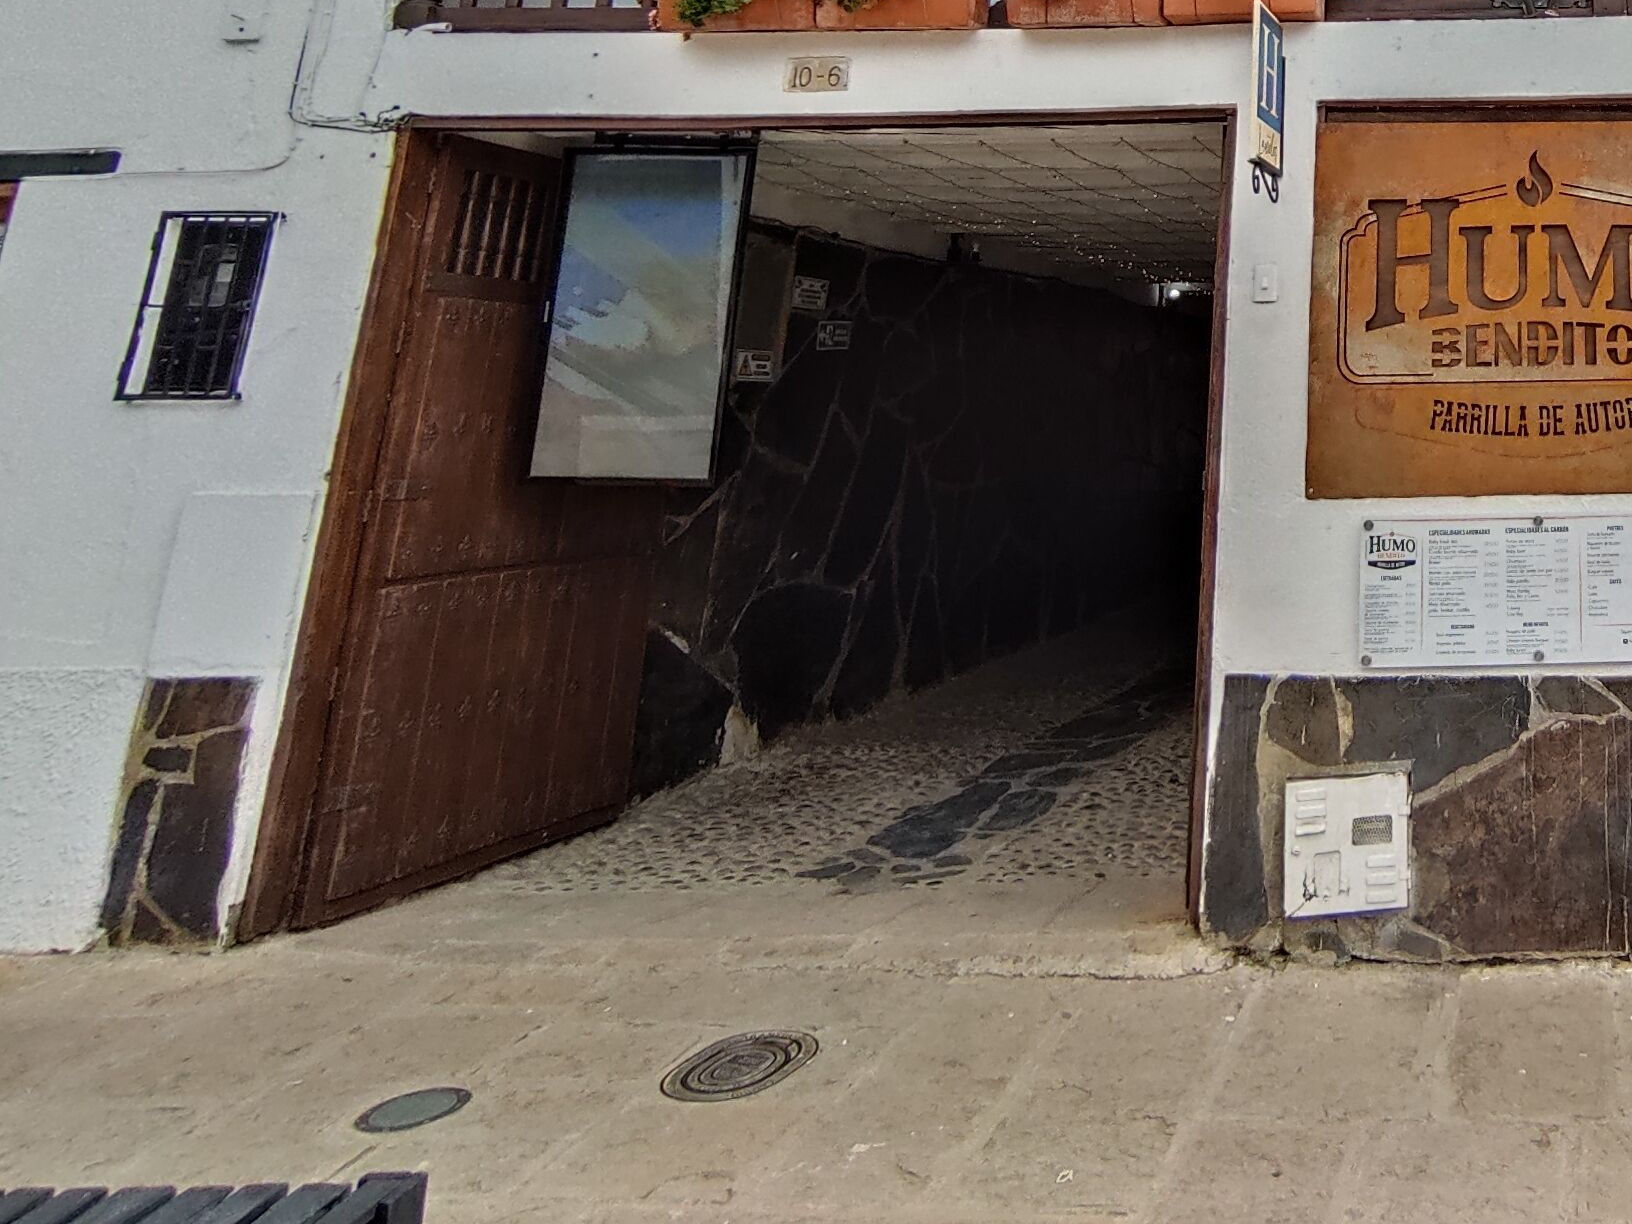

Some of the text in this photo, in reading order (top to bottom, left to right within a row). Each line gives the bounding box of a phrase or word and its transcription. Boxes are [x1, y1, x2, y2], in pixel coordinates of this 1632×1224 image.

[1260, 23, 1280, 120] H
[1430, 399, 1529, 437] PARRILLA
[1537, 404, 1565, 436] DE
[1369, 535, 1415, 554] HUMO
